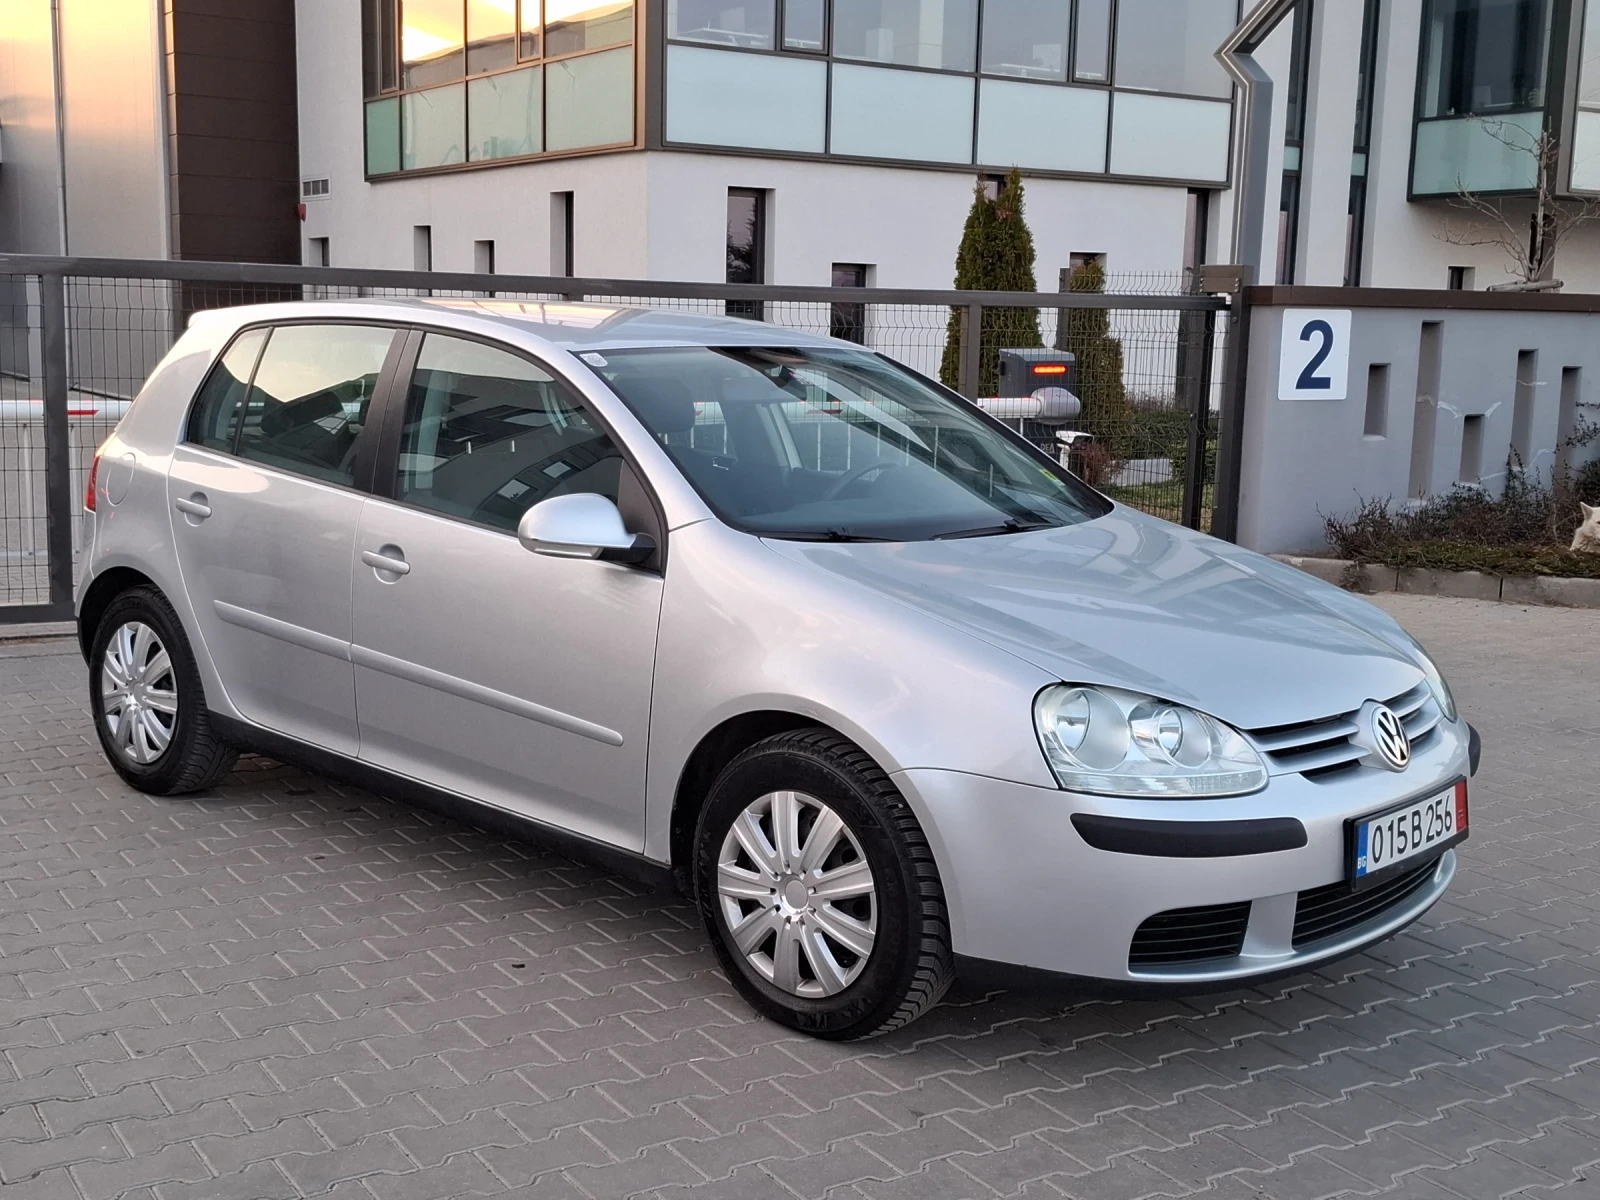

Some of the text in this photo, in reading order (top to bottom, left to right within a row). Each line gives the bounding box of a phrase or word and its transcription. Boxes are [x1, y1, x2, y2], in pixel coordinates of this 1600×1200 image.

[1295, 319, 1334, 390] 2
[1358, 855, 1367, 869] BG
[1372, 795, 1452, 863] 015B256
